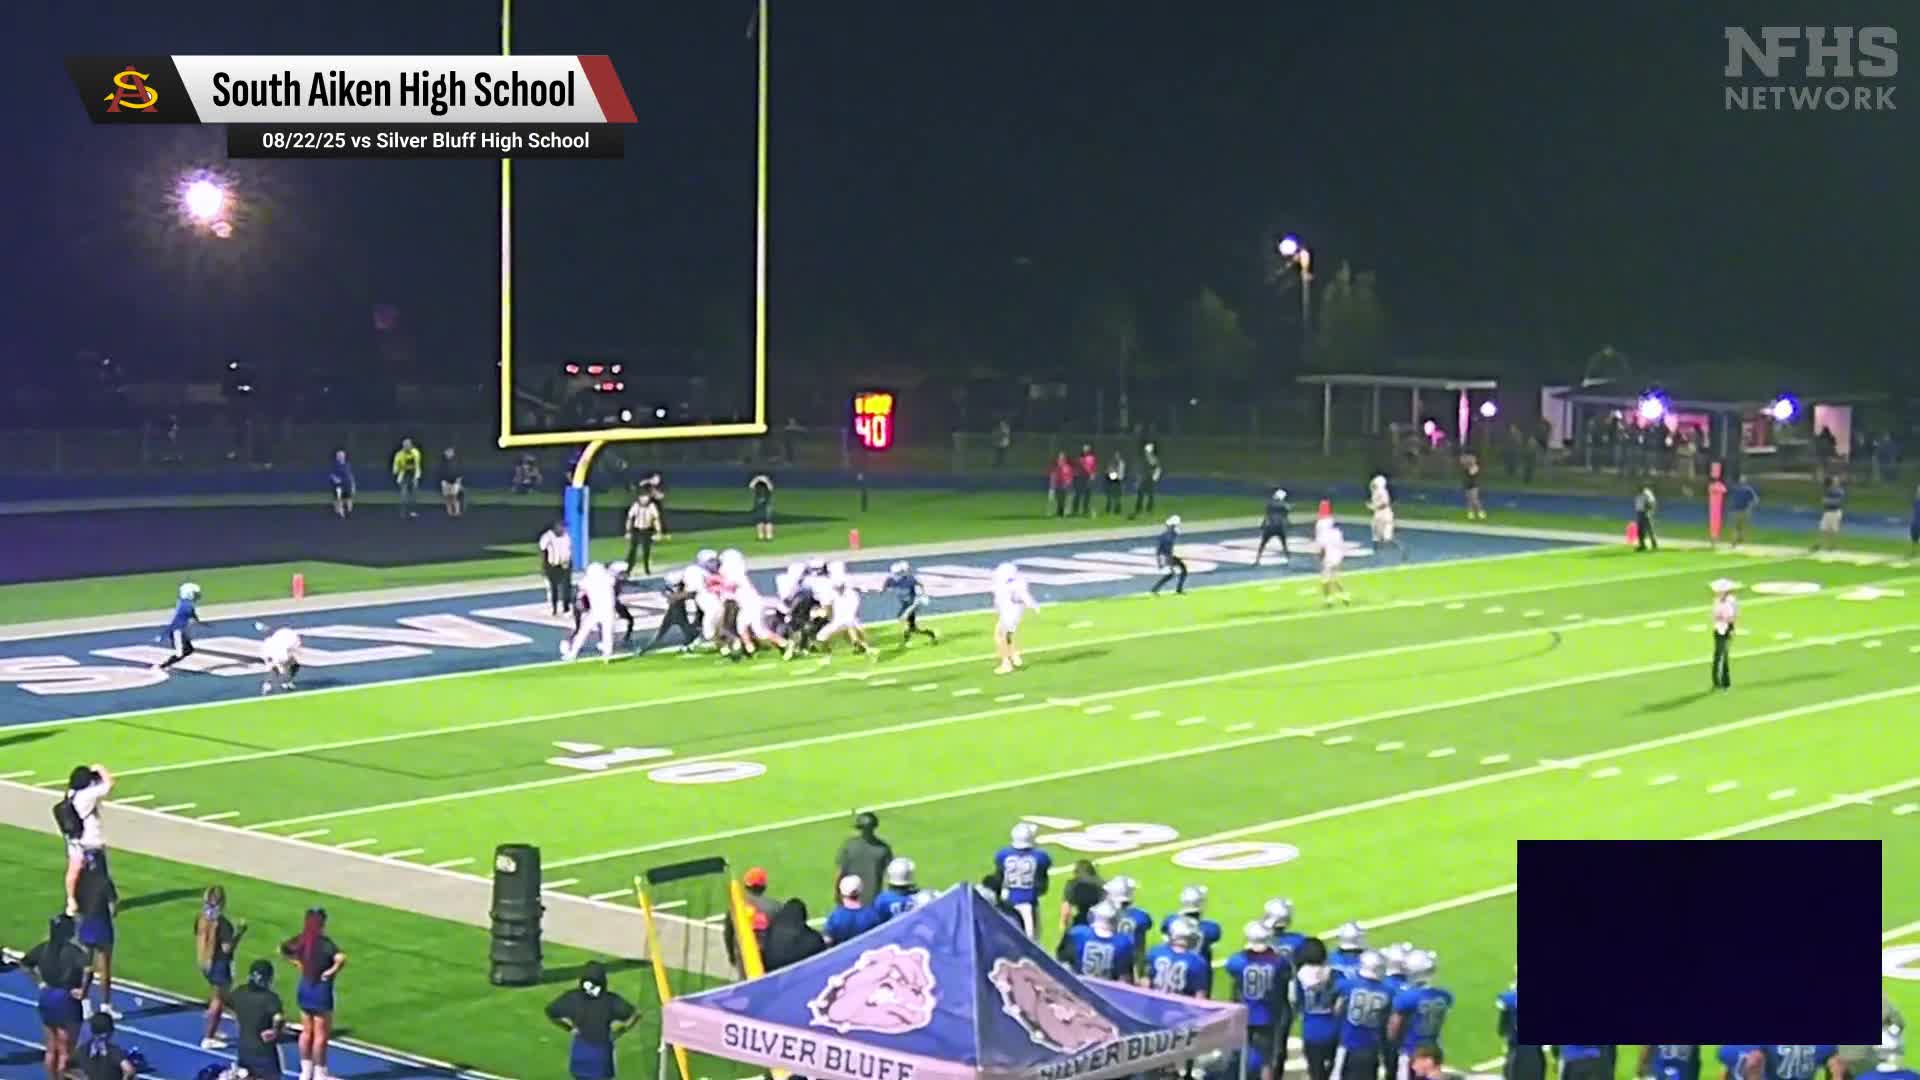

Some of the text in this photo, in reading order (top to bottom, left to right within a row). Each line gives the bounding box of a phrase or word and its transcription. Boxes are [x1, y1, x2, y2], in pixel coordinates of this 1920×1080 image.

[855, 415, 886, 448] 40
[1004, 855, 1037, 888] 22
[1082, 940, 1115, 977] 51
[723, 1022, 914, 1080] SILVER BLUFF
